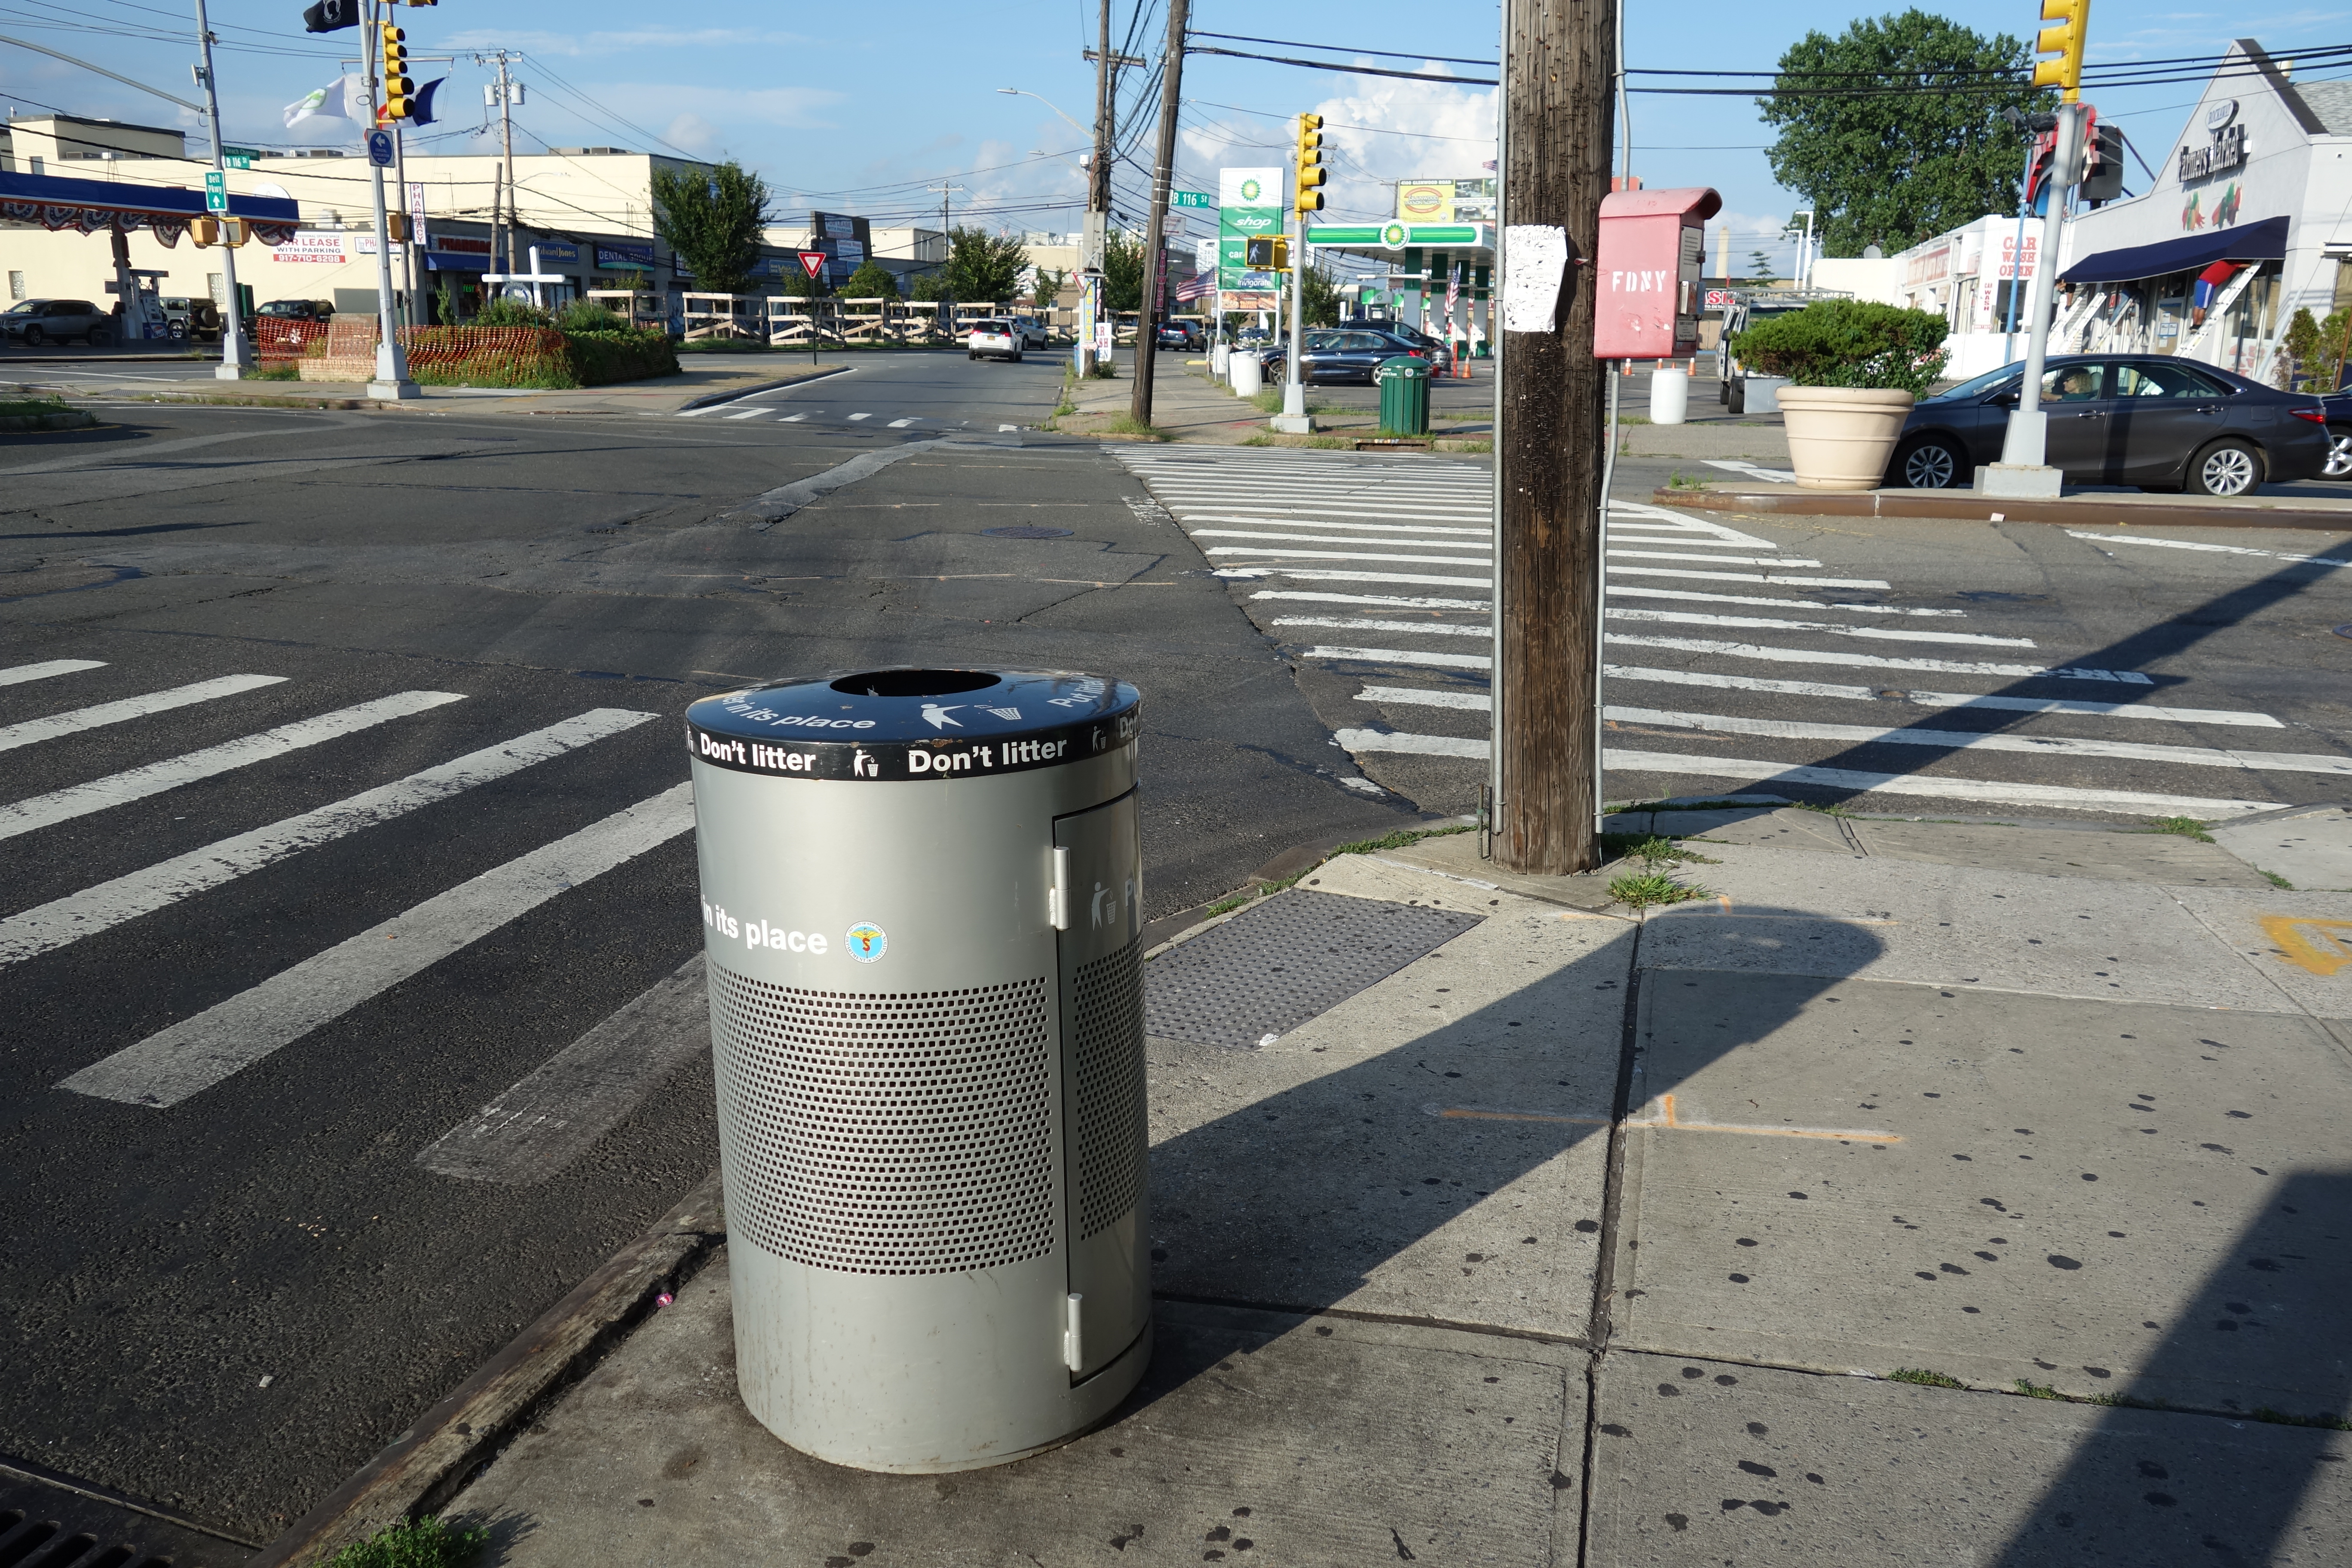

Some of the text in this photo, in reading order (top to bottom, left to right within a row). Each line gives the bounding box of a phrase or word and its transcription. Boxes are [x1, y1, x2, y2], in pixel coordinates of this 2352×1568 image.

[2208, 103, 2231, 125] ROCKAWAY
[240, 149, 257, 157] Channel
[2177, 125, 2243, 183] Farmers Market
[226, 157, 231, 167] B
[233, 157, 241, 167] 116
[208, 174, 220, 183] Belt
[208, 185, 222, 195] Pkwy
[1173, 192, 1179, 203] B
[1183, 193, 1197, 205] 116
[413, 184, 423, 243] PHARMACY
[1235, 215, 1272, 229] shop
[2003, 236, 2037, 250] CAR
[537, 245, 576, 257] Edward Jones
[599, 251, 653, 263] DENTAL GROUP
[279, 254, 340, 263] 917-710-6298
[2000, 265, 2034, 276] OPEN
[1156, 249, 1167, 308] CAR WASH
[1612, 270, 1666, 292] FDNY
[1084, 309, 1093, 340] WASH
[1047, 693, 1098, 707] Put
[725, 702, 756, 713] in
[740, 708, 779, 721] its
[770, 716, 876, 729] place
[700, 732, 816, 772] Don't litter
[909, 739, 1067, 773] Don't litter
[703, 894, 828, 955] in its place
[845, 936, 866, 962] DEPARTMENT
[872, 936, 887, 962] SANITATION
